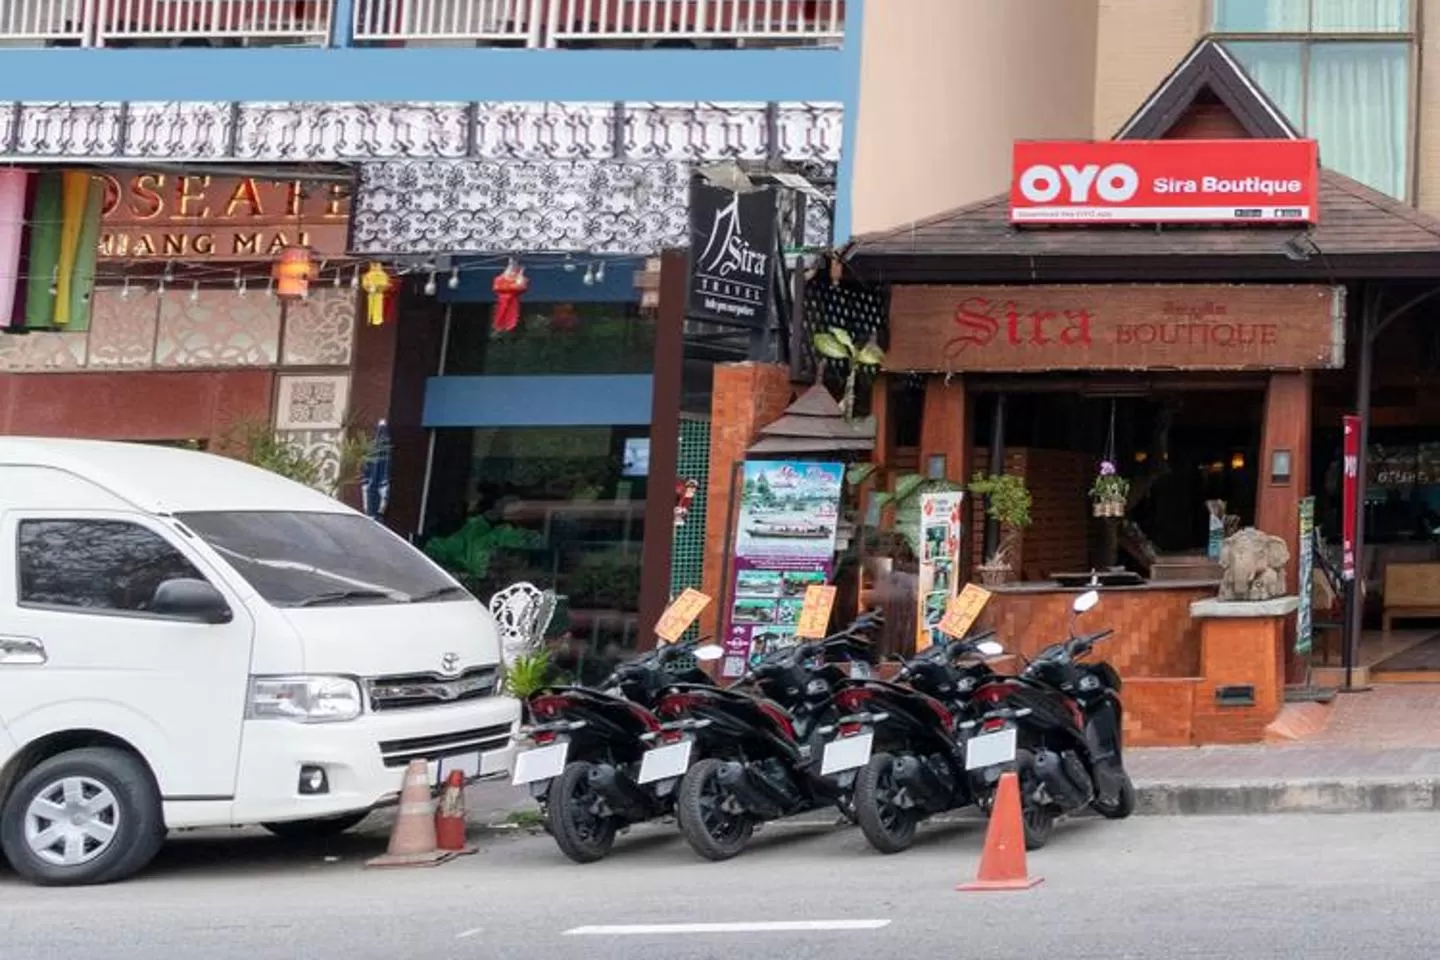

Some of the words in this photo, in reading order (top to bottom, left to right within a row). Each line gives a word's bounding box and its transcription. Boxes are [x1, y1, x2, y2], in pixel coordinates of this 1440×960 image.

[1019, 163, 1139, 202] OYO
[1153, 177, 1197, 193] Sira
[1201, 175, 1302, 196] Boutique
[720, 235, 767, 276] Sira
[943, 296, 1095, 360] Sira
[1115, 323, 1278, 346] BOUTIQUE
